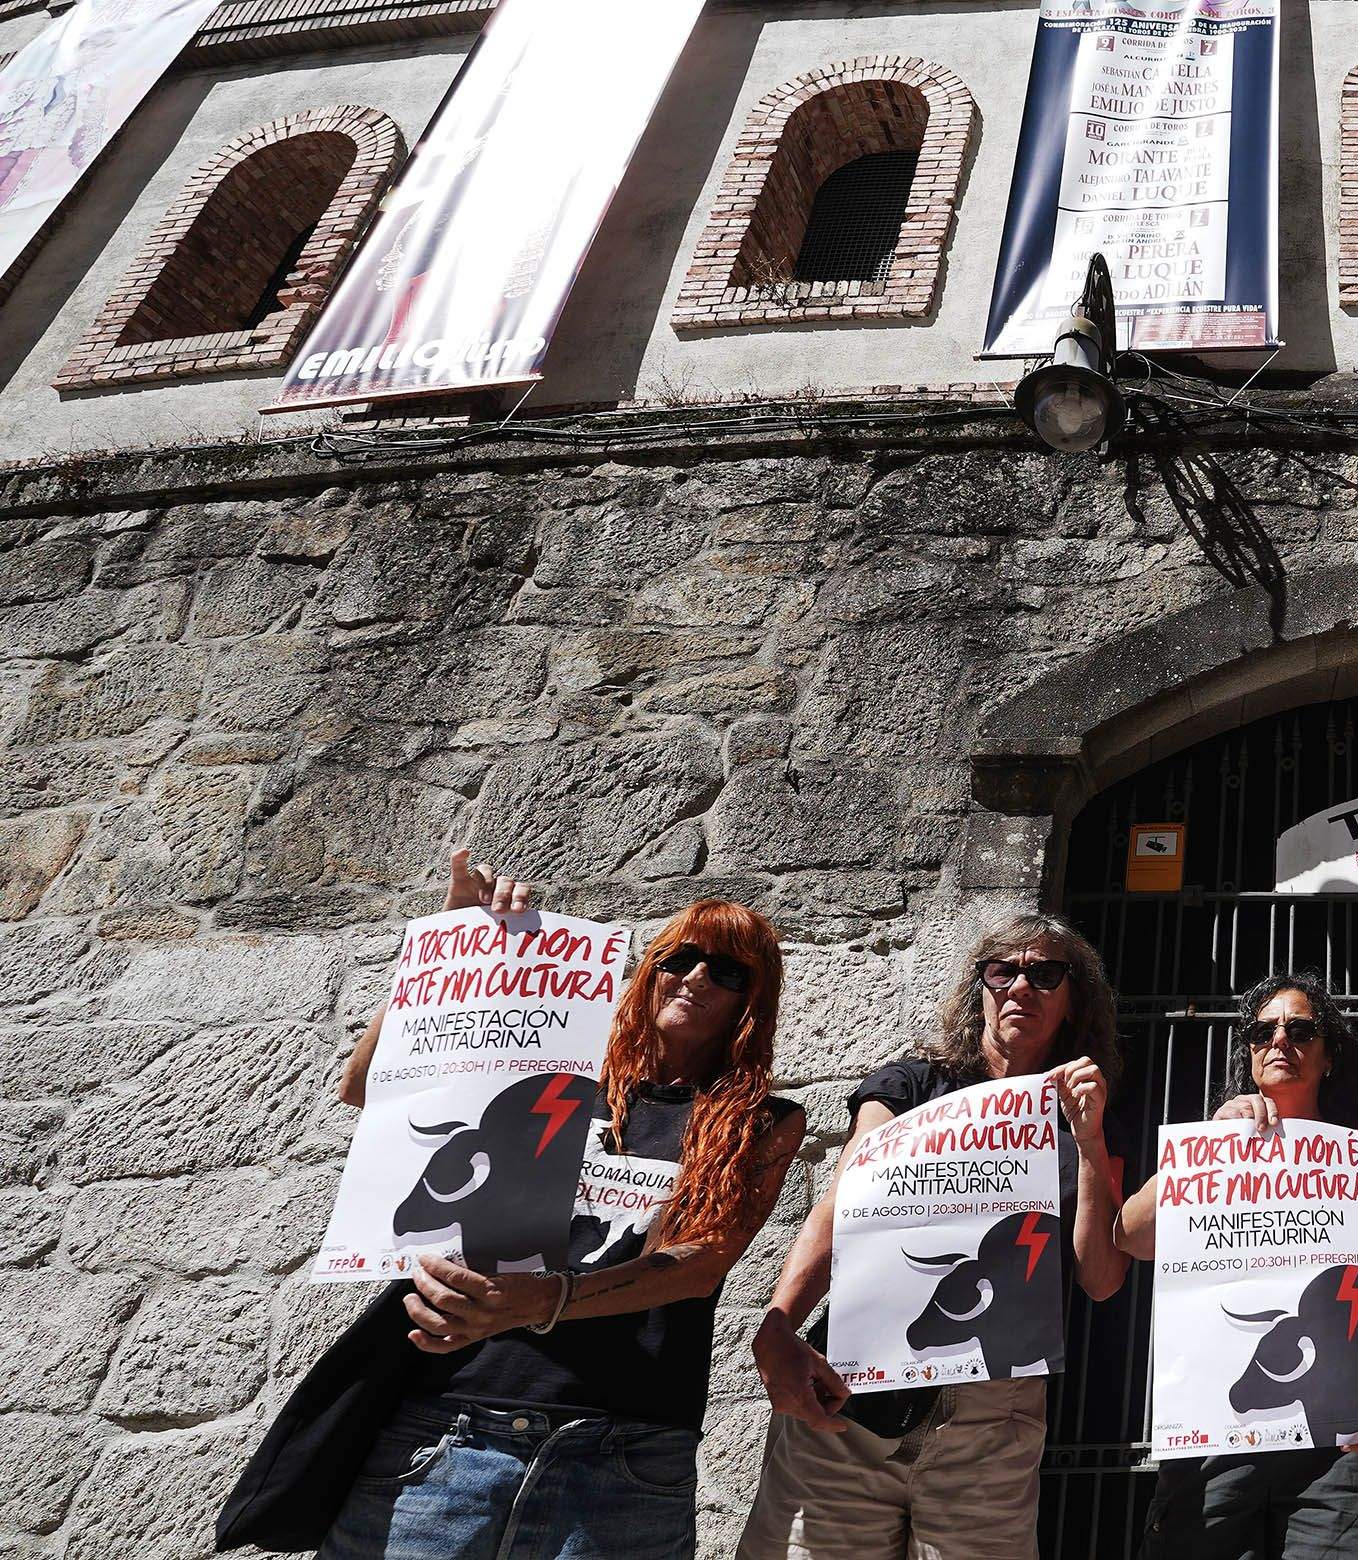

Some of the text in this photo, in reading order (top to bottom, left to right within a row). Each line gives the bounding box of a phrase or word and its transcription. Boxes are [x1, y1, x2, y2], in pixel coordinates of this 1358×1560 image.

[1110, 18, 1128, 26] 125
[1132, 21, 1196, 31] ANIVERSAO
[1122, 38, 1156, 48] CORRIDA
[1142, 64, 1212, 80] CATELLA
[1121, 80, 1219, 98] MANANARES
[1090, 95, 1144, 114] EMILIO
[1171, 97, 1216, 115] JUSTO
[1087, 123, 1105, 137] 10
[1133, 163, 1212, 184] TALAVANTE
[1082, 191, 1125, 203] DANIEL
[1124, 260, 1203, 280] LUQUE
[1192, 305, 1222, 313] ECUESTRE
[1223, 304, 1241, 313] PURA
[399, 934, 413, 968] A
[417, 920, 507, 967] TORTURA
[601, 930, 626, 965] É
[389, 967, 442, 1011] ARTE
[485, 962, 613, 1003] CULTURA
[402, 1005, 569, 1038] MANIFESTACIÓN
[409, 1030, 542, 1056] ANTITAURINA
[372, 1059, 594, 1084] 9 DE AGOSTO 20:30H P. PEREGRINA
[855, 1137, 869, 1153] A
[879, 1097, 971, 1140] TORTURA
[1040, 1079, 1057, 1117] É
[846, 1133, 906, 1171] ARTE
[960, 1120, 1056, 1151] CULTURA
[1159, 1139, 1177, 1170] A
[1181, 1132, 1286, 1168] TORTURA
[1348, 1131, 1358, 1166] É
[871, 1155, 1029, 1182] MANIFESTACIÓN
[887, 1177, 1014, 1197] ANTITAURINA
[1159, 1169, 1224, 1207] ARTE
[841, 1200, 1055, 1219] 9 DE AGOSTO 20:30H P. PEREGRINA
[1189, 1205, 1344, 1232] MANIFESTACIÓN
[1205, 1227, 1331, 1250] ANTITAURINA
[1162, 1263, 1169, 1273] 9
[1172, 1262, 1188, 1272] DE
[1191, 1259, 1243, 1271] AGOSTO
[1251, 1256, 1291, 1268] 20:30H
[1300, 1255, 1309, 1265] P.
